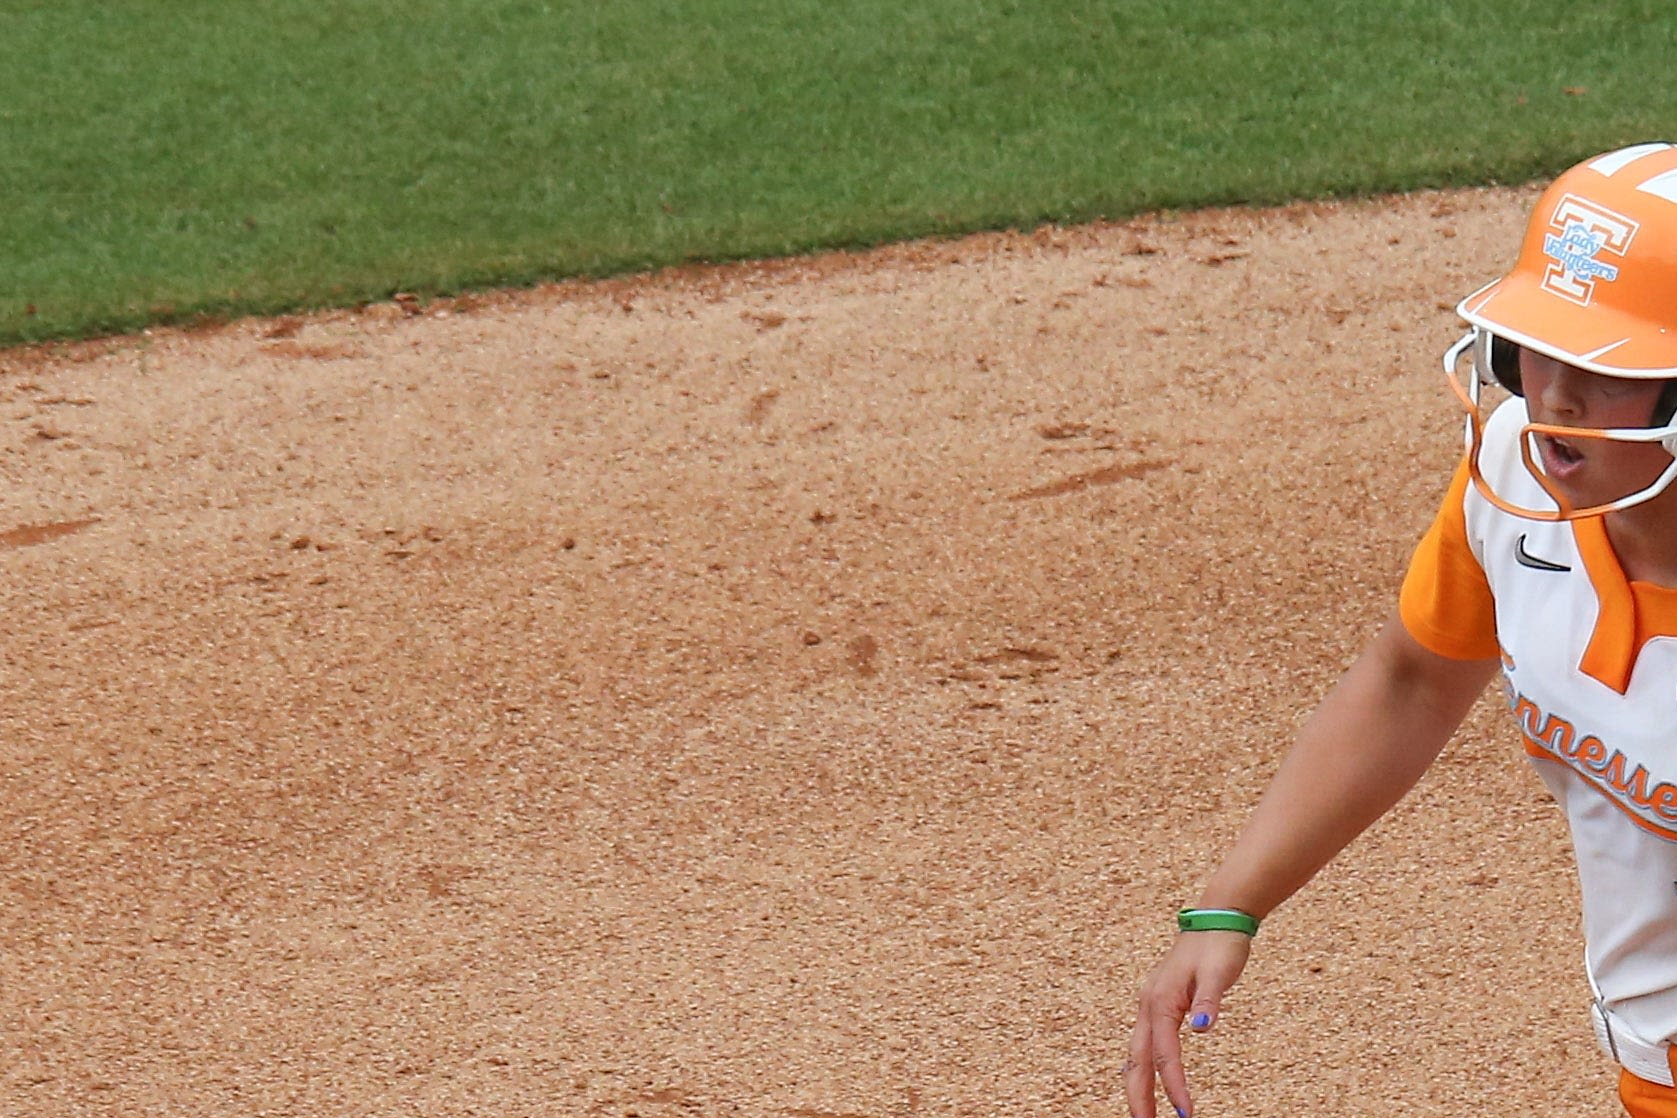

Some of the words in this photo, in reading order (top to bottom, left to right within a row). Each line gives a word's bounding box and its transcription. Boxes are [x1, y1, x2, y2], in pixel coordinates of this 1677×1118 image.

[1541, 192, 1640, 308] T
[1544, 233, 1617, 282] Volunteers
[1562, 224, 1602, 258] Lady
